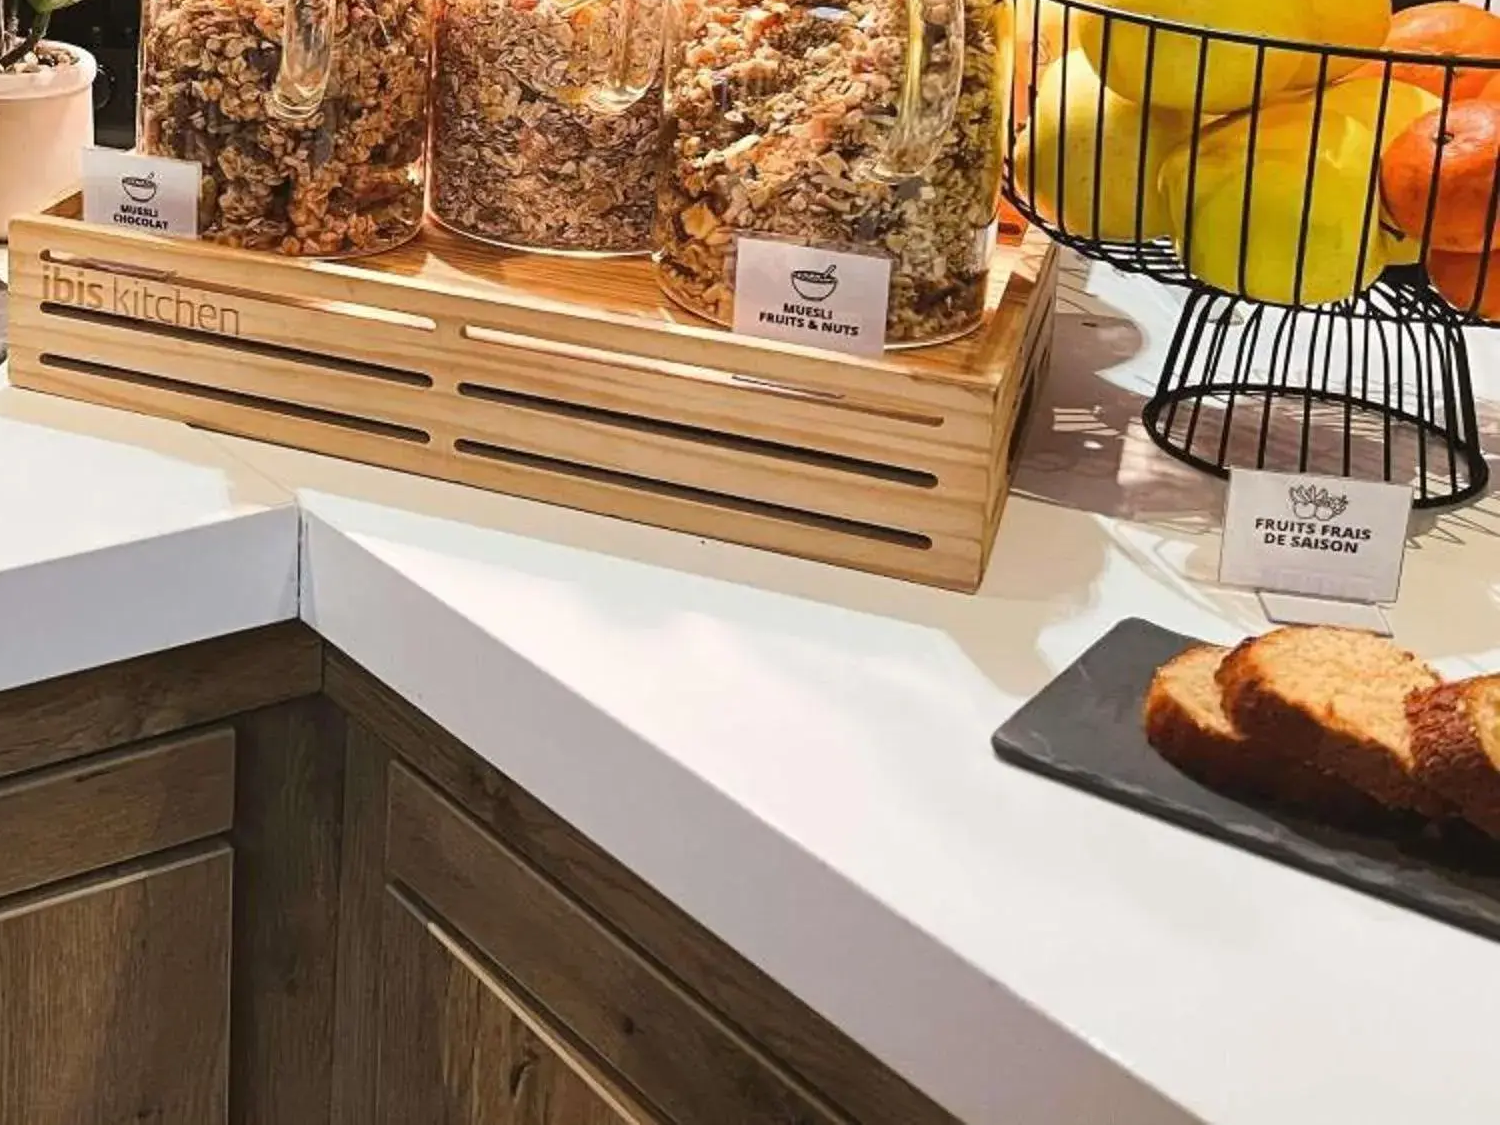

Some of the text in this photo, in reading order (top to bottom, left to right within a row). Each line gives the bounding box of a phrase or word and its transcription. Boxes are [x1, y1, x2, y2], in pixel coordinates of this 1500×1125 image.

[113, 213, 169, 231] CHOCOLAT
[119, 203, 160, 219] MUESLI
[41, 264, 240, 336] ibis kitchen
[782, 302, 834, 321] MUESLI
[758, 311, 861, 337] FRUITS & NUTS
[1255, 517, 1372, 541] FRUITS FRAIS
[1263, 532, 1358, 554] DE SAISON
